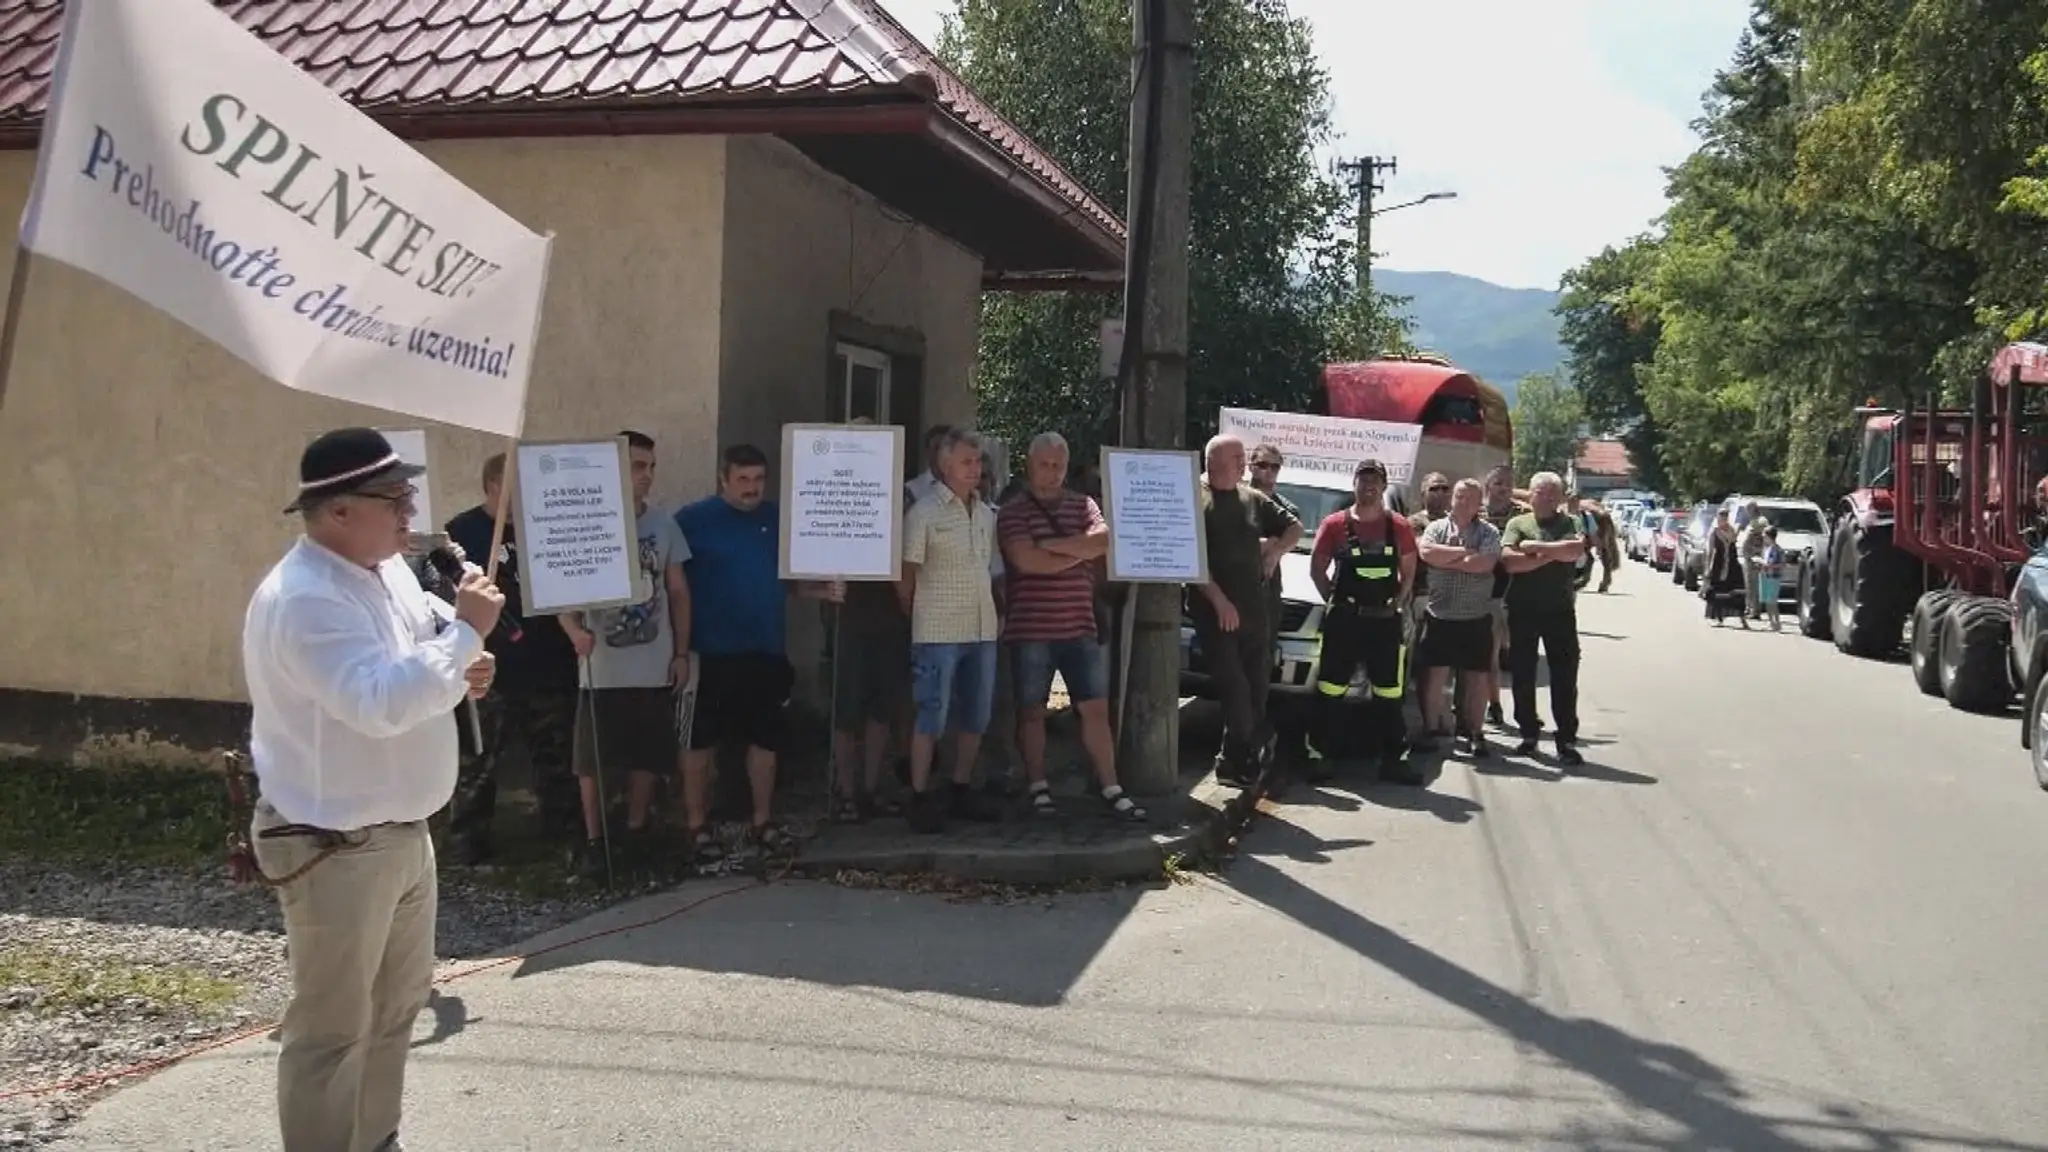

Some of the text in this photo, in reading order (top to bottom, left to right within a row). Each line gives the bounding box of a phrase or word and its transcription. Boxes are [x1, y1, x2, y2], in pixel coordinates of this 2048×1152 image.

[82, 124, 295, 301] Prehodnoťte
[407, 316, 515, 379] územia!
[180, 91, 434, 278] SPLŇTE
